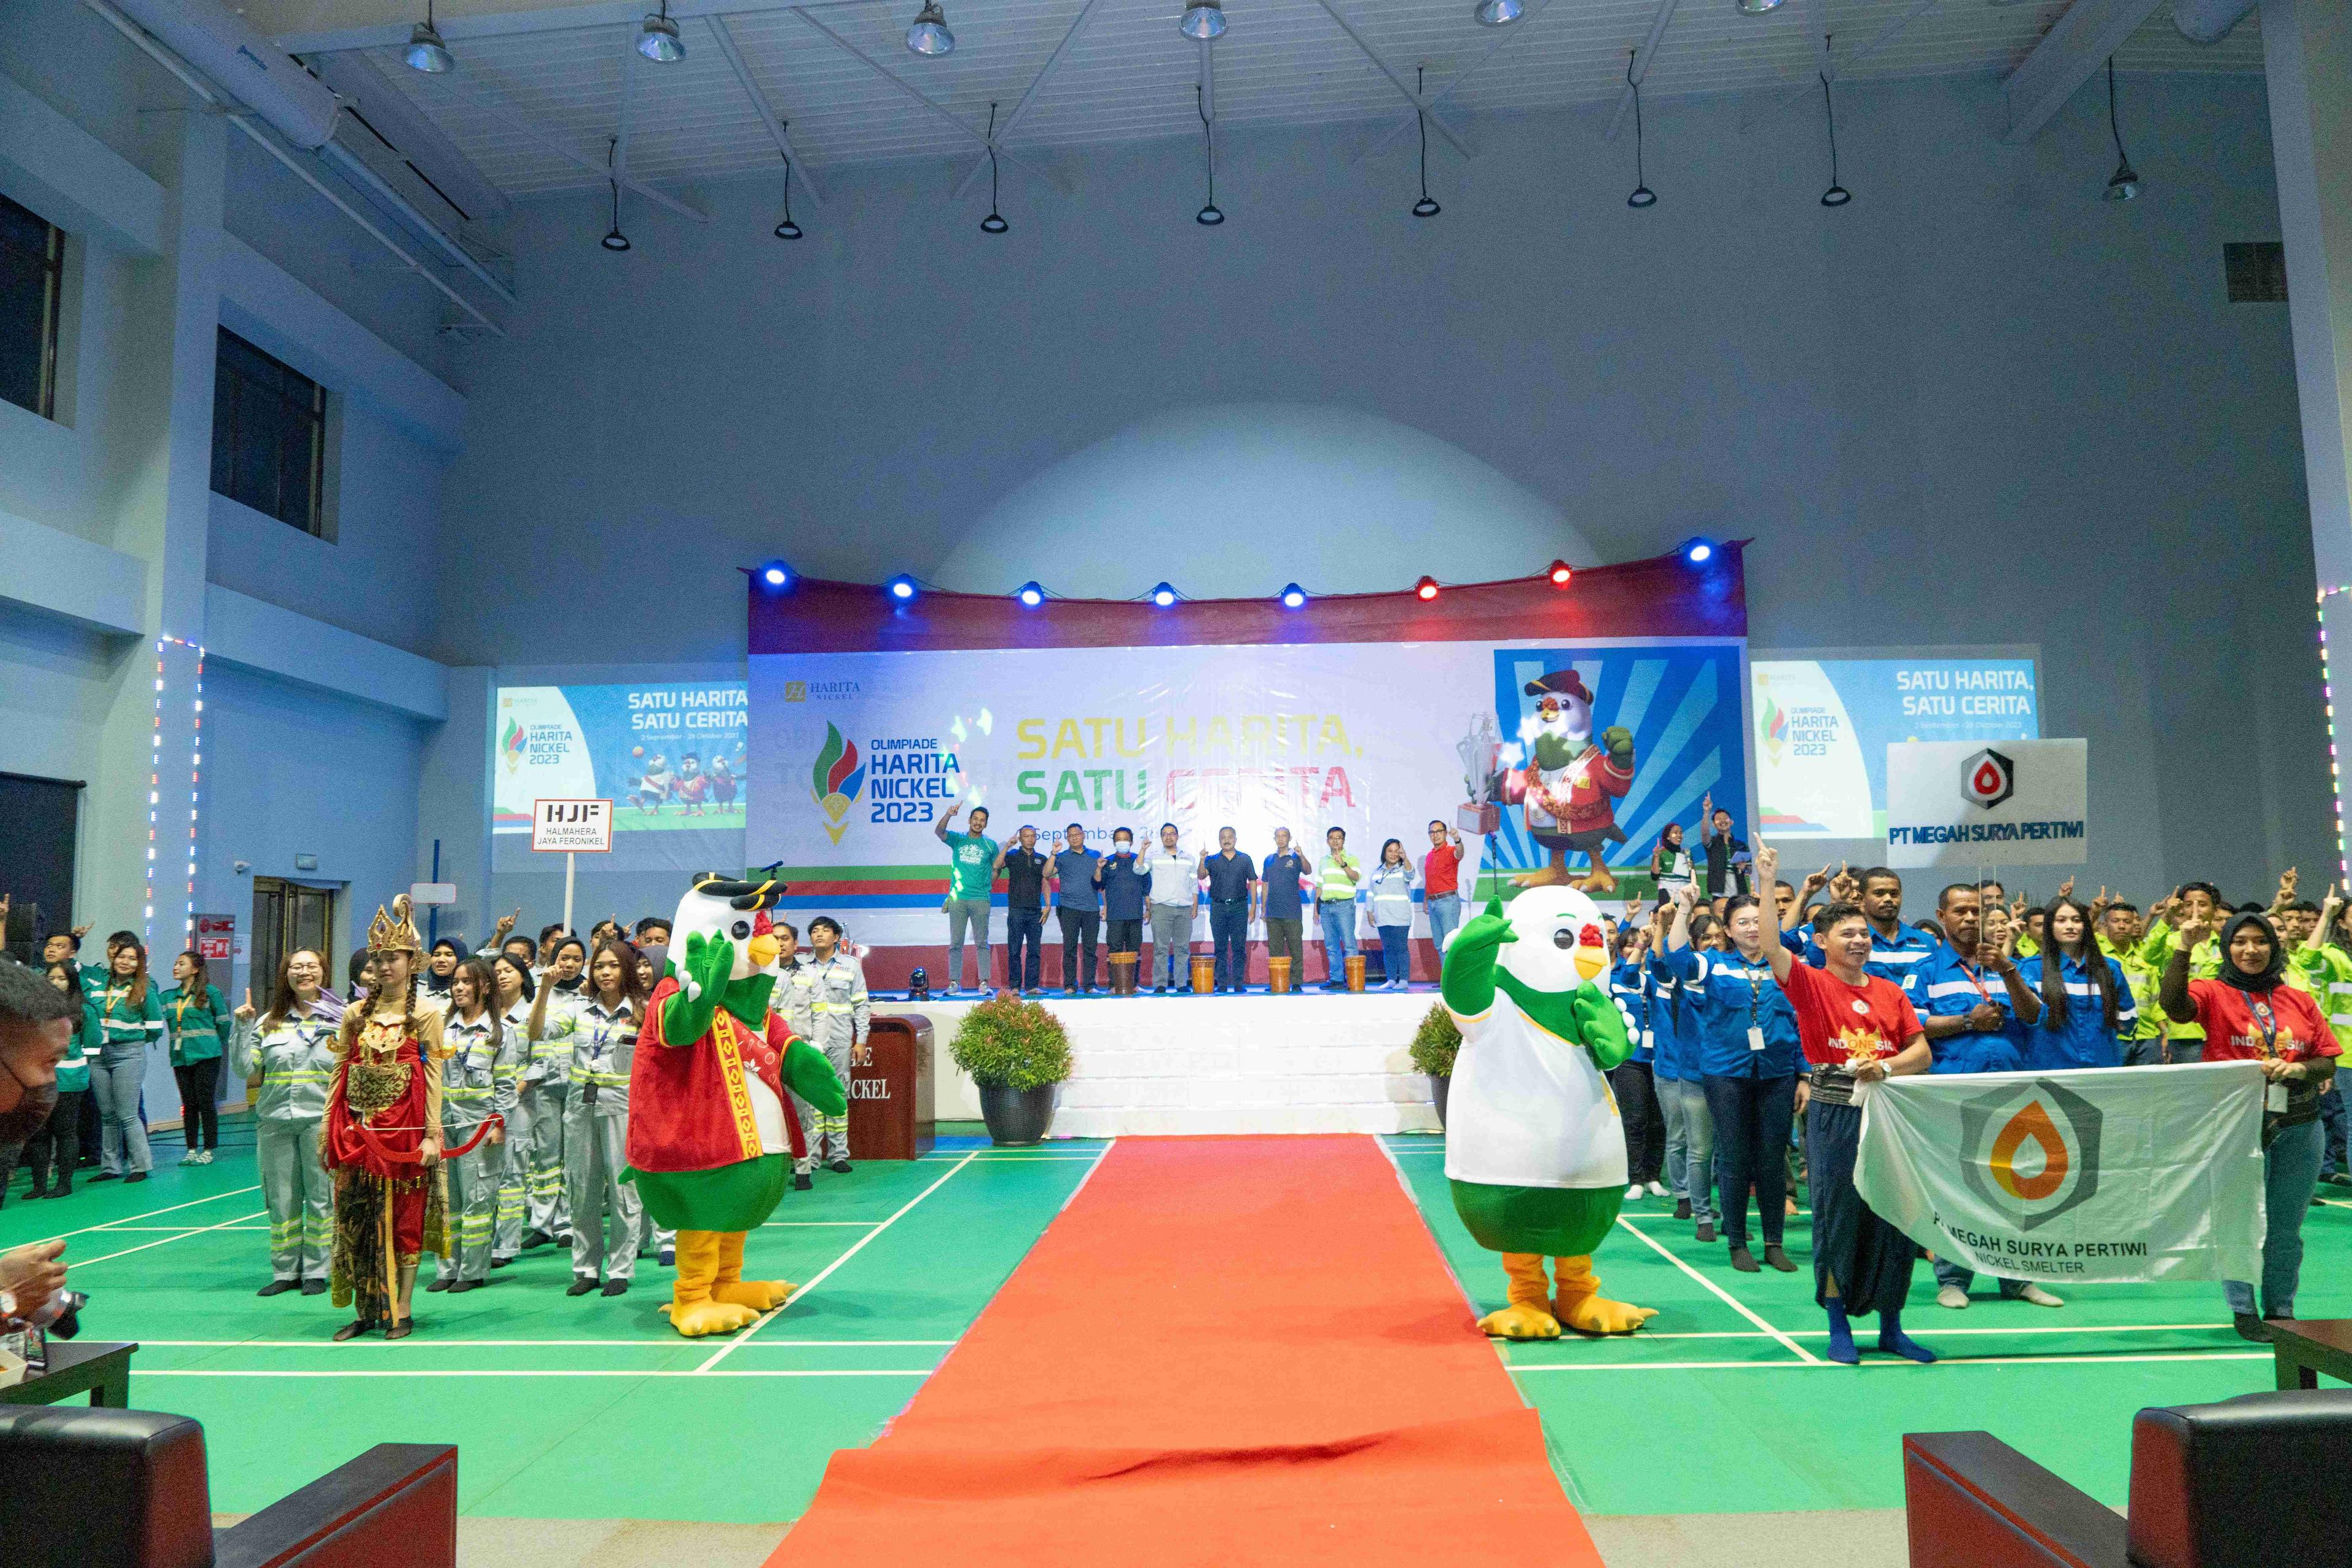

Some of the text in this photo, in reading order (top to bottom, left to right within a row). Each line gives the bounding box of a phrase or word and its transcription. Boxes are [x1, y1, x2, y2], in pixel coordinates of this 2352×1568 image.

[810, 682, 860, 692] HARITA
[1897, 670, 2034, 691] SATU HARITA,
[628, 690, 748, 709] SATU HARITA
[1902, 696, 2031, 715] SATU CERITA
[631, 711, 748, 729] SATU CERITA
[1792, 716, 1839, 728] HARITA
[530, 731, 572, 741] HARITA
[871, 739, 937, 750] OLIMPIADE
[1017, 714, 1363, 760] SATU HARITA,
[1792, 730, 1837, 742] NICKEL
[530, 743, 570, 753] NICKEL
[1793, 744, 1826, 755] 2023
[530, 755, 559, 764] 2023
[872, 753, 960, 775] HARITA
[872, 778, 955, 799] NICKEL
[1017, 766, 1356, 812] SATU CTA
[547, 805, 599, 822] HJF
[872, 802, 933, 823] 2023
[1890, 820, 2084, 845] PT MEGAH SURYA PERTIWI
[2231, 1035, 2304, 1052] INDOESIA
[848, 1079, 891, 1099] CKEL
[2007, 1240, 2068, 1257] SURYA
[2075, 1243, 2147, 1257] PERTIWI
[1975, 1251, 2085, 1273] NICKEL SMELTER
